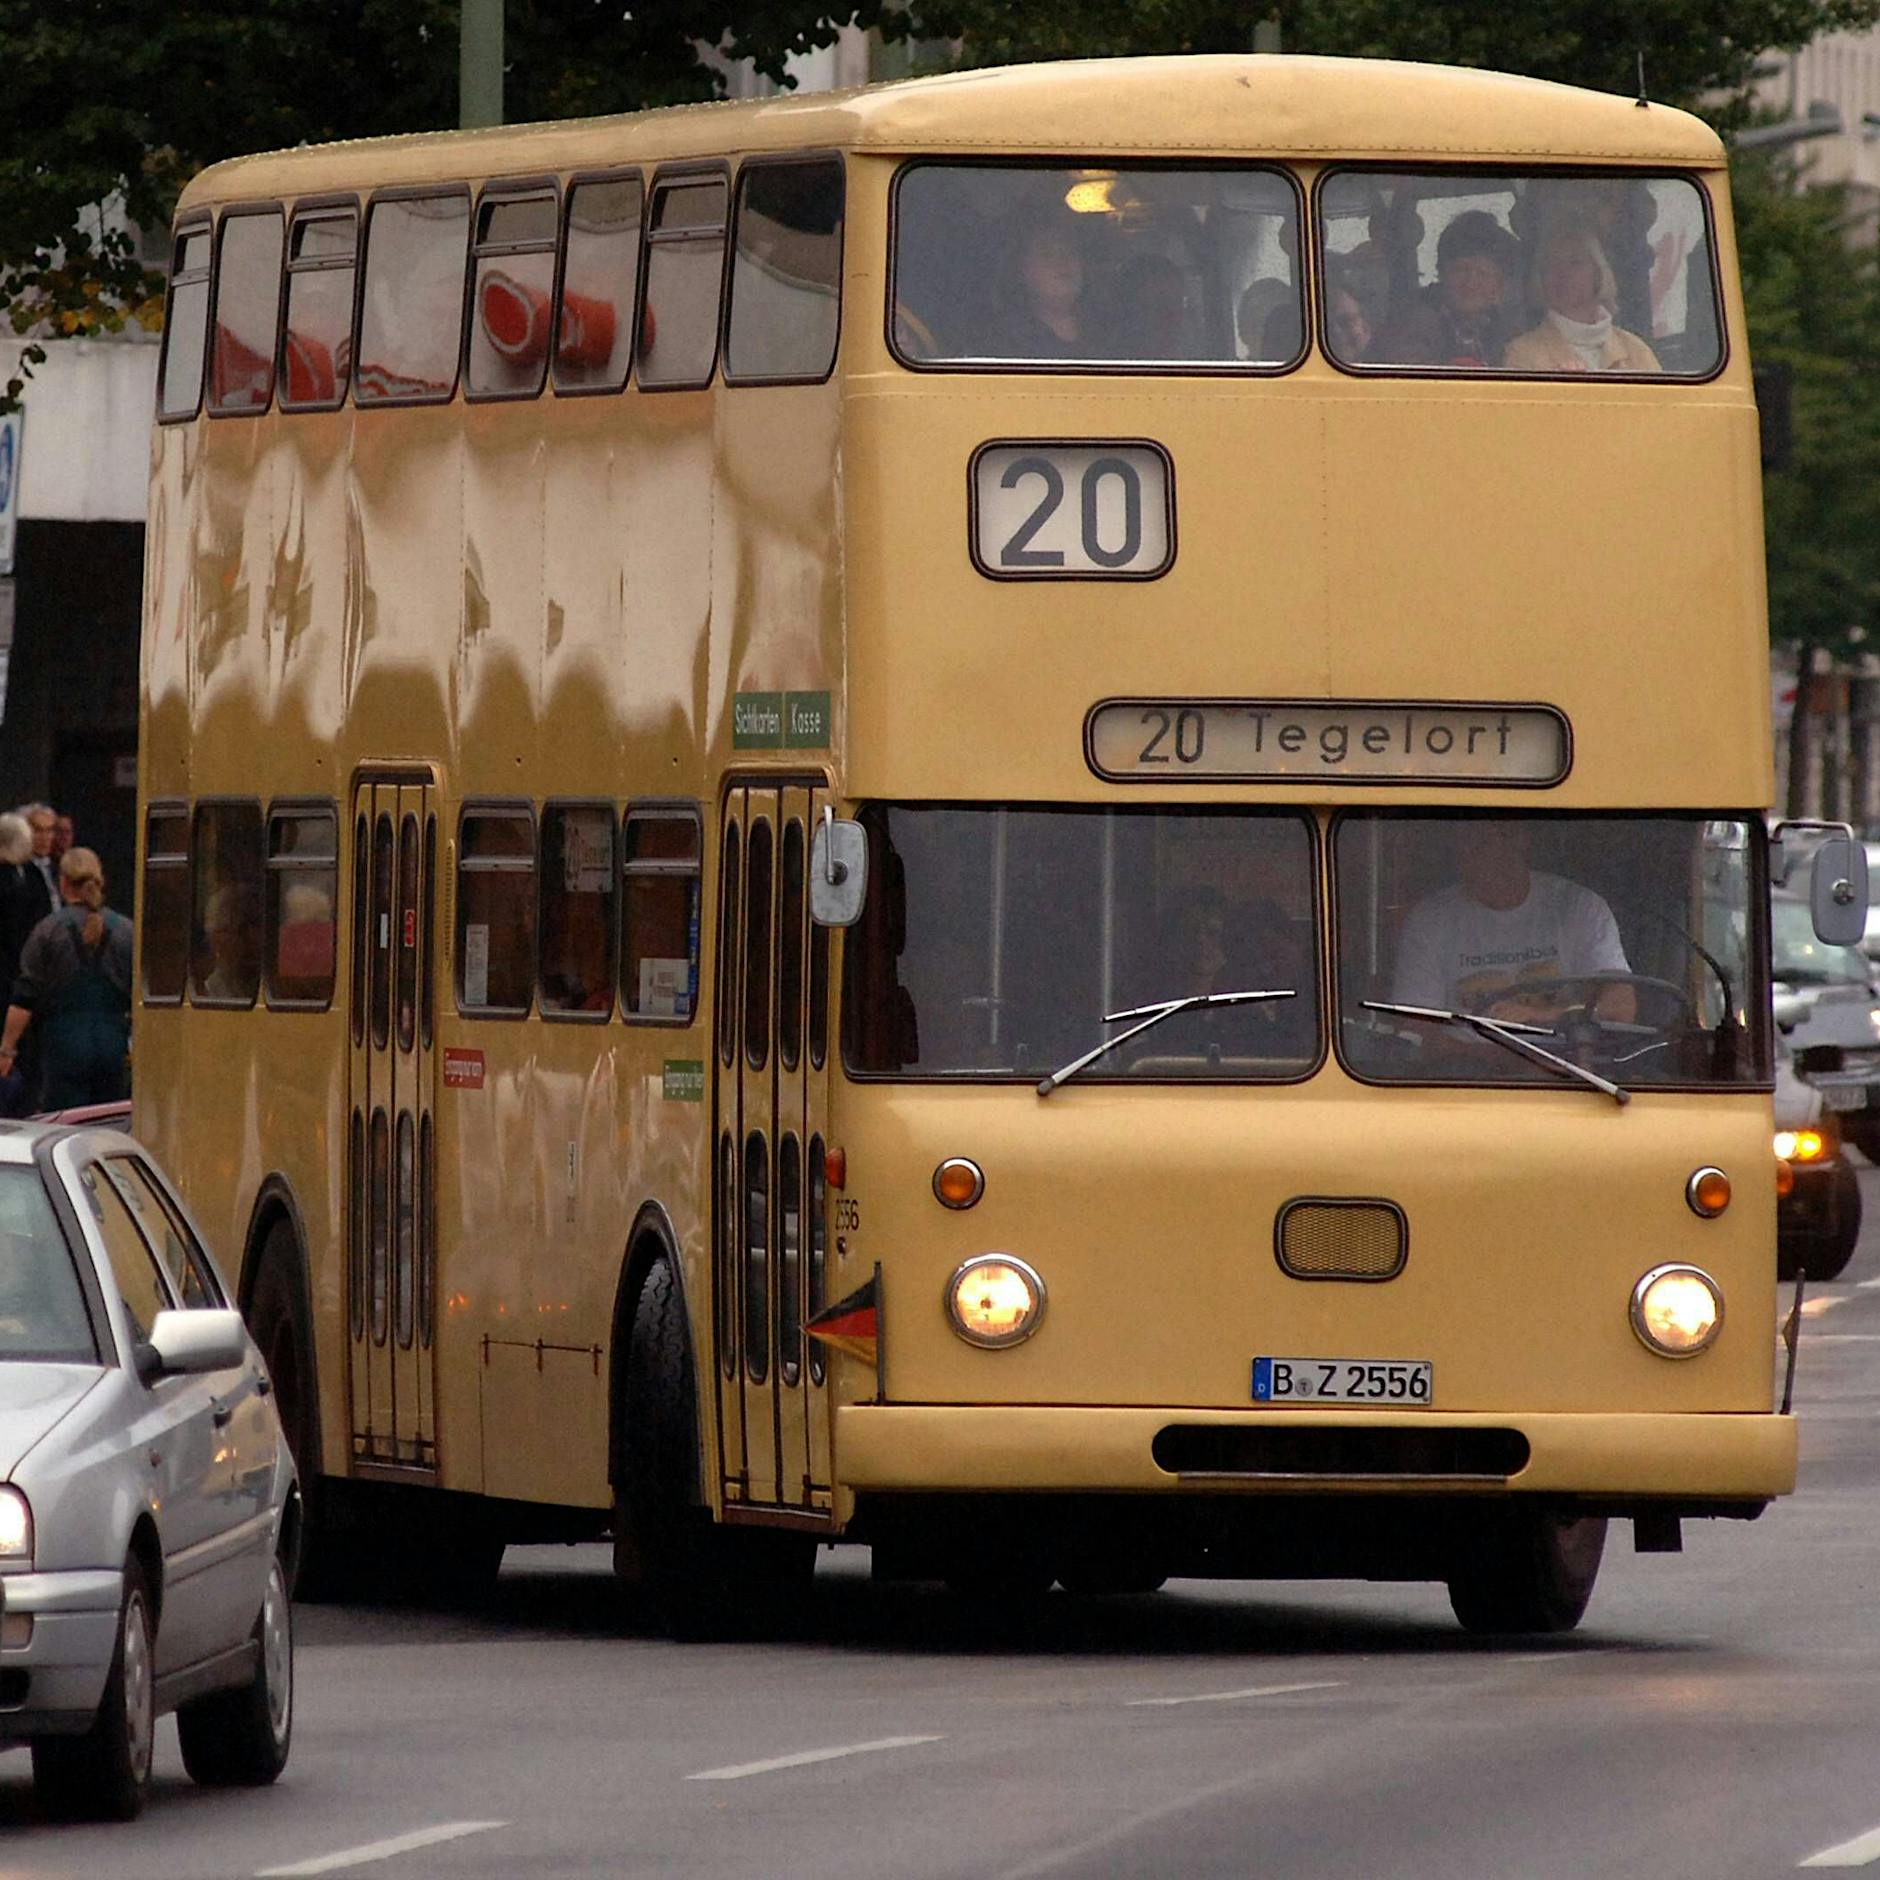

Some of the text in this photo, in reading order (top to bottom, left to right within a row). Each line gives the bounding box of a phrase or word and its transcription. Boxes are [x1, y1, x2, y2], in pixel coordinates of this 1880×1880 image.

[1000, 457, 1141, 568] 20
[791, 703, 821, 734] Kasse
[1139, 708, 1511, 763] 20 Tegelort
[1273, 1363, 1294, 1395] B
[1316, 1364, 1338, 1396] Z
[1346, 1366, 1428, 1398] 2556
